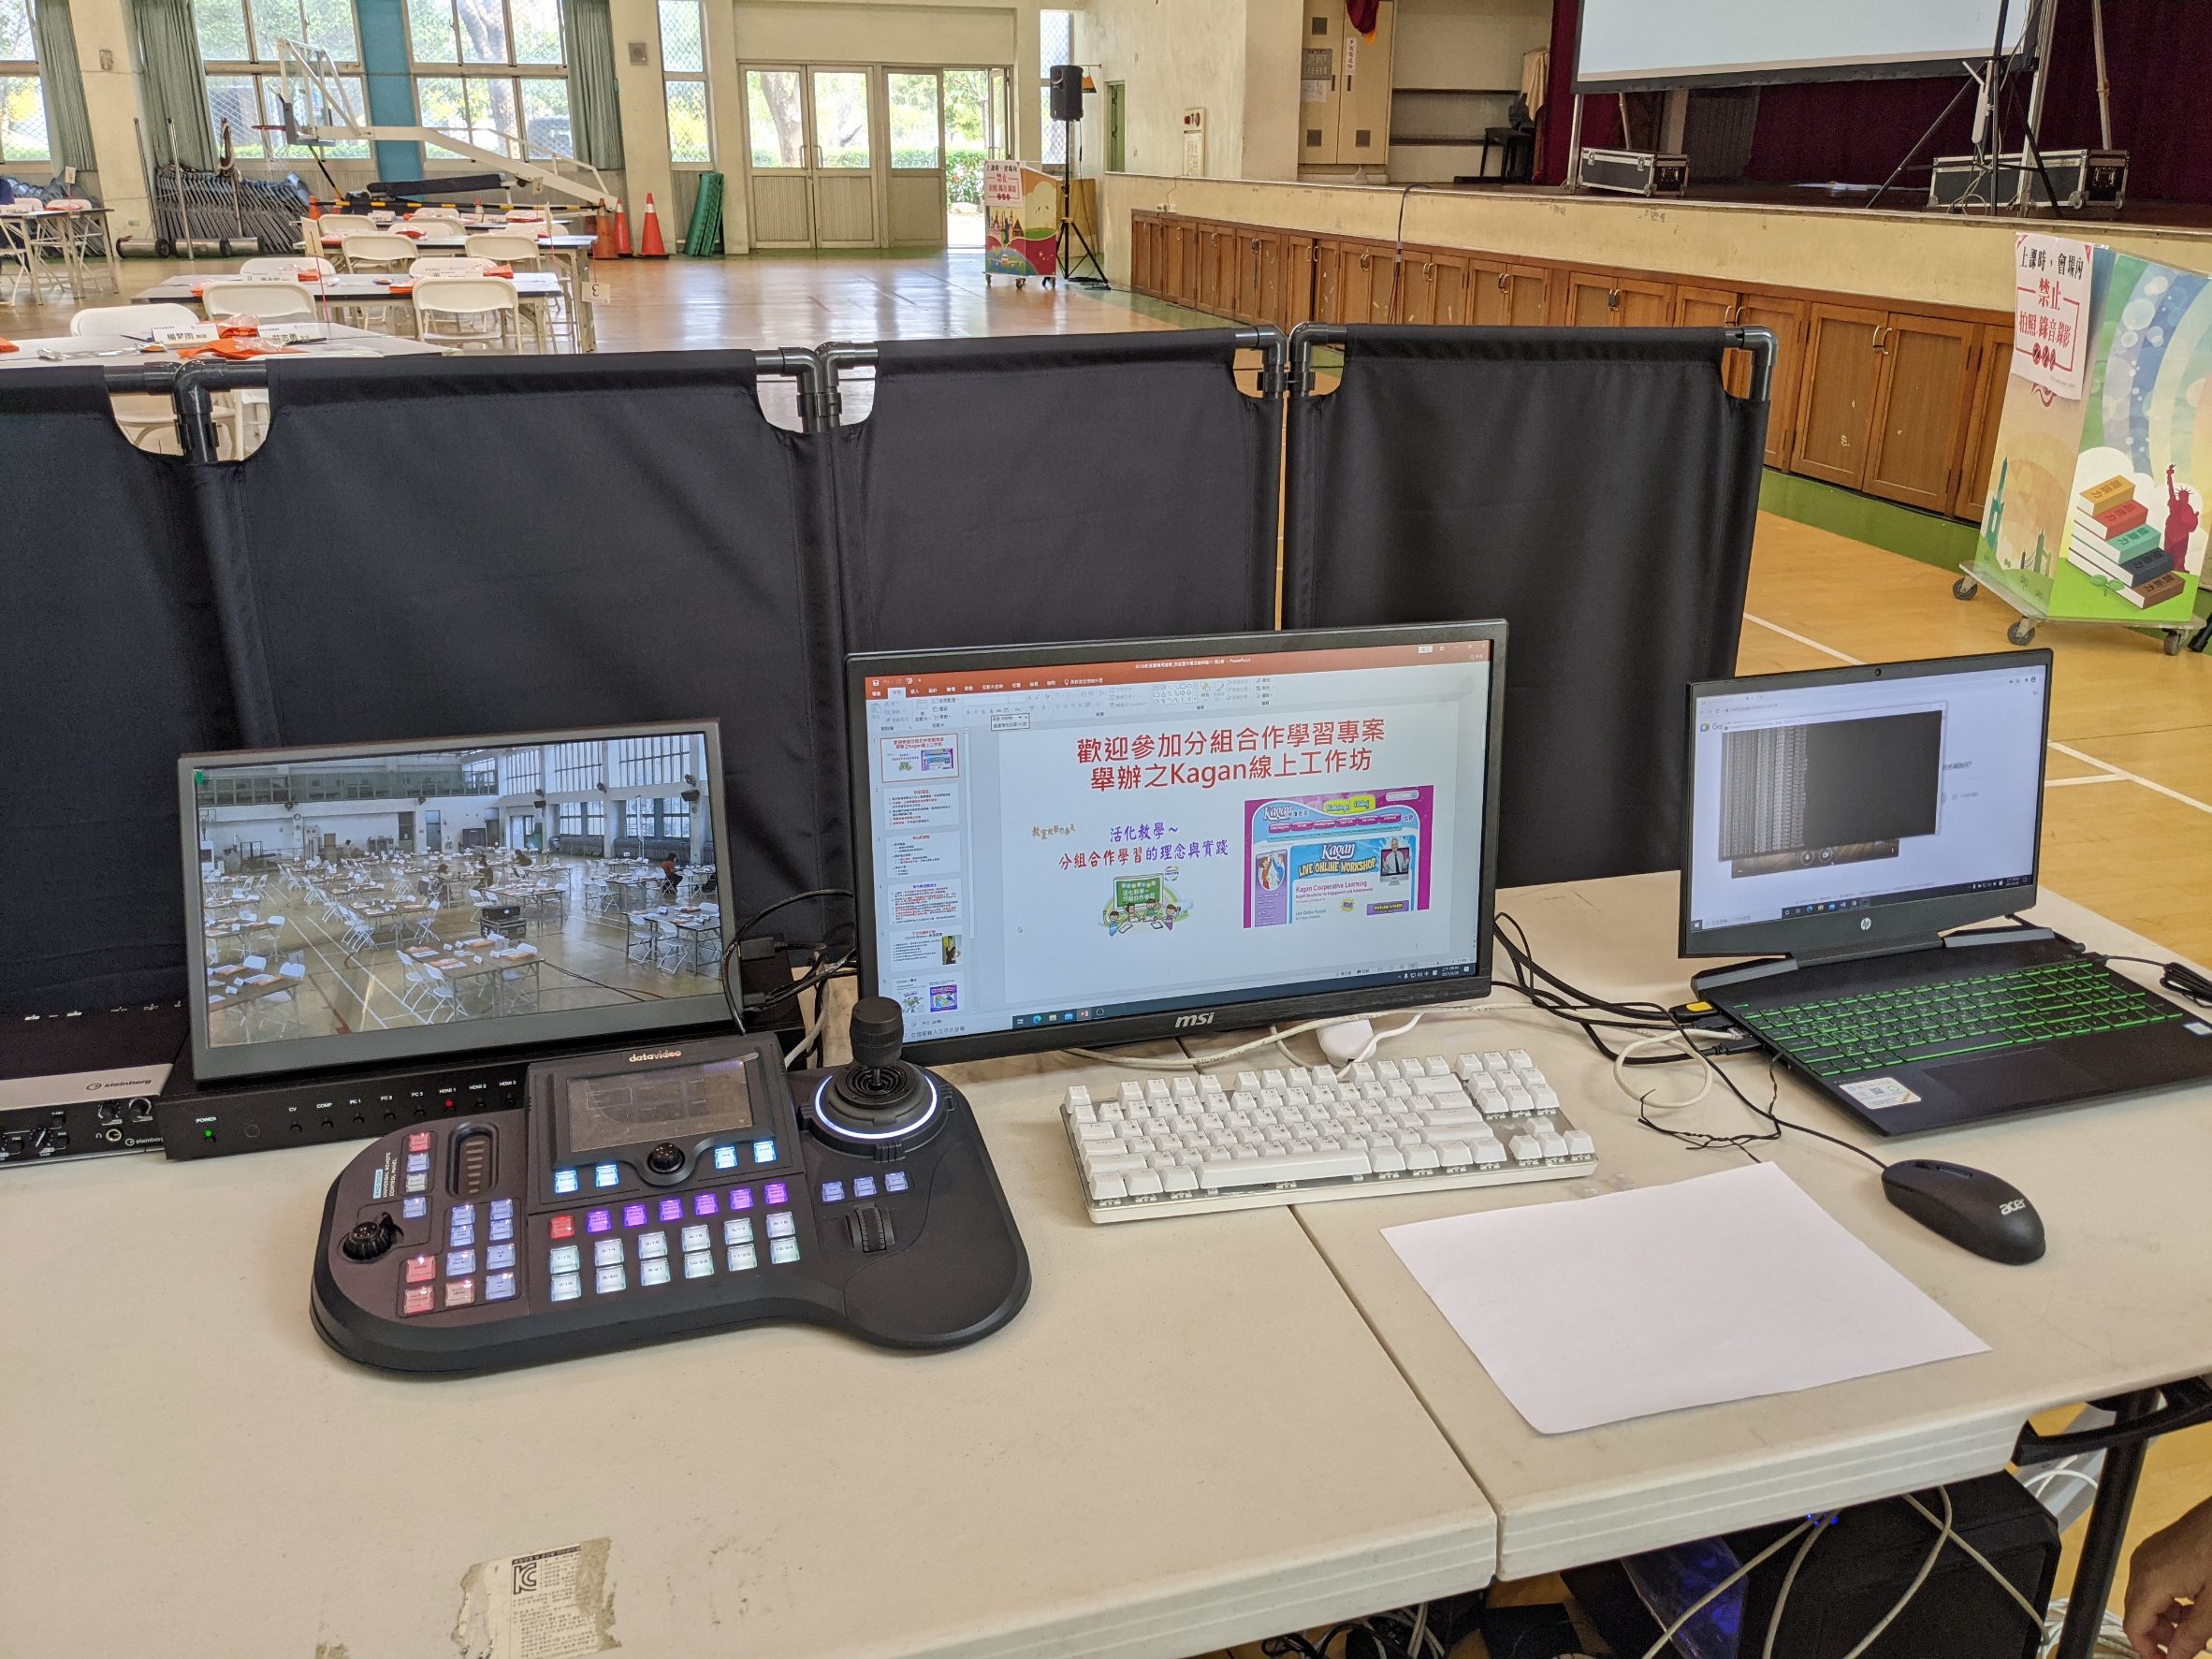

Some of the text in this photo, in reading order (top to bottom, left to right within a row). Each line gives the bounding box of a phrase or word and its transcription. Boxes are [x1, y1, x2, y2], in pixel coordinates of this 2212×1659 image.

[2038, 277, 2061, 311] 禁止
[1077, 717, 1385, 764] 歡迎參加分組合作學習專案
[1090, 748, 1372, 793] 舉辦之Kagan線上工作坊
[1263, 806, 1293, 821] Kagan
[1058, 838, 1229, 871] 分組合作學習的理念與實踐
[1320, 843, 1356, 860] Kagan
[1298, 856, 1376, 878] LIVE ONLINE WORKSHOP
[1296, 880, 1367, 894] Kagan Cooperative Learning
[1174, 1012, 1215, 1028] msi
[629, 1050, 682, 1062] datavideo
[104, 1079, 152, 1088] steinberg
[1999, 1199, 2026, 1215] acer
